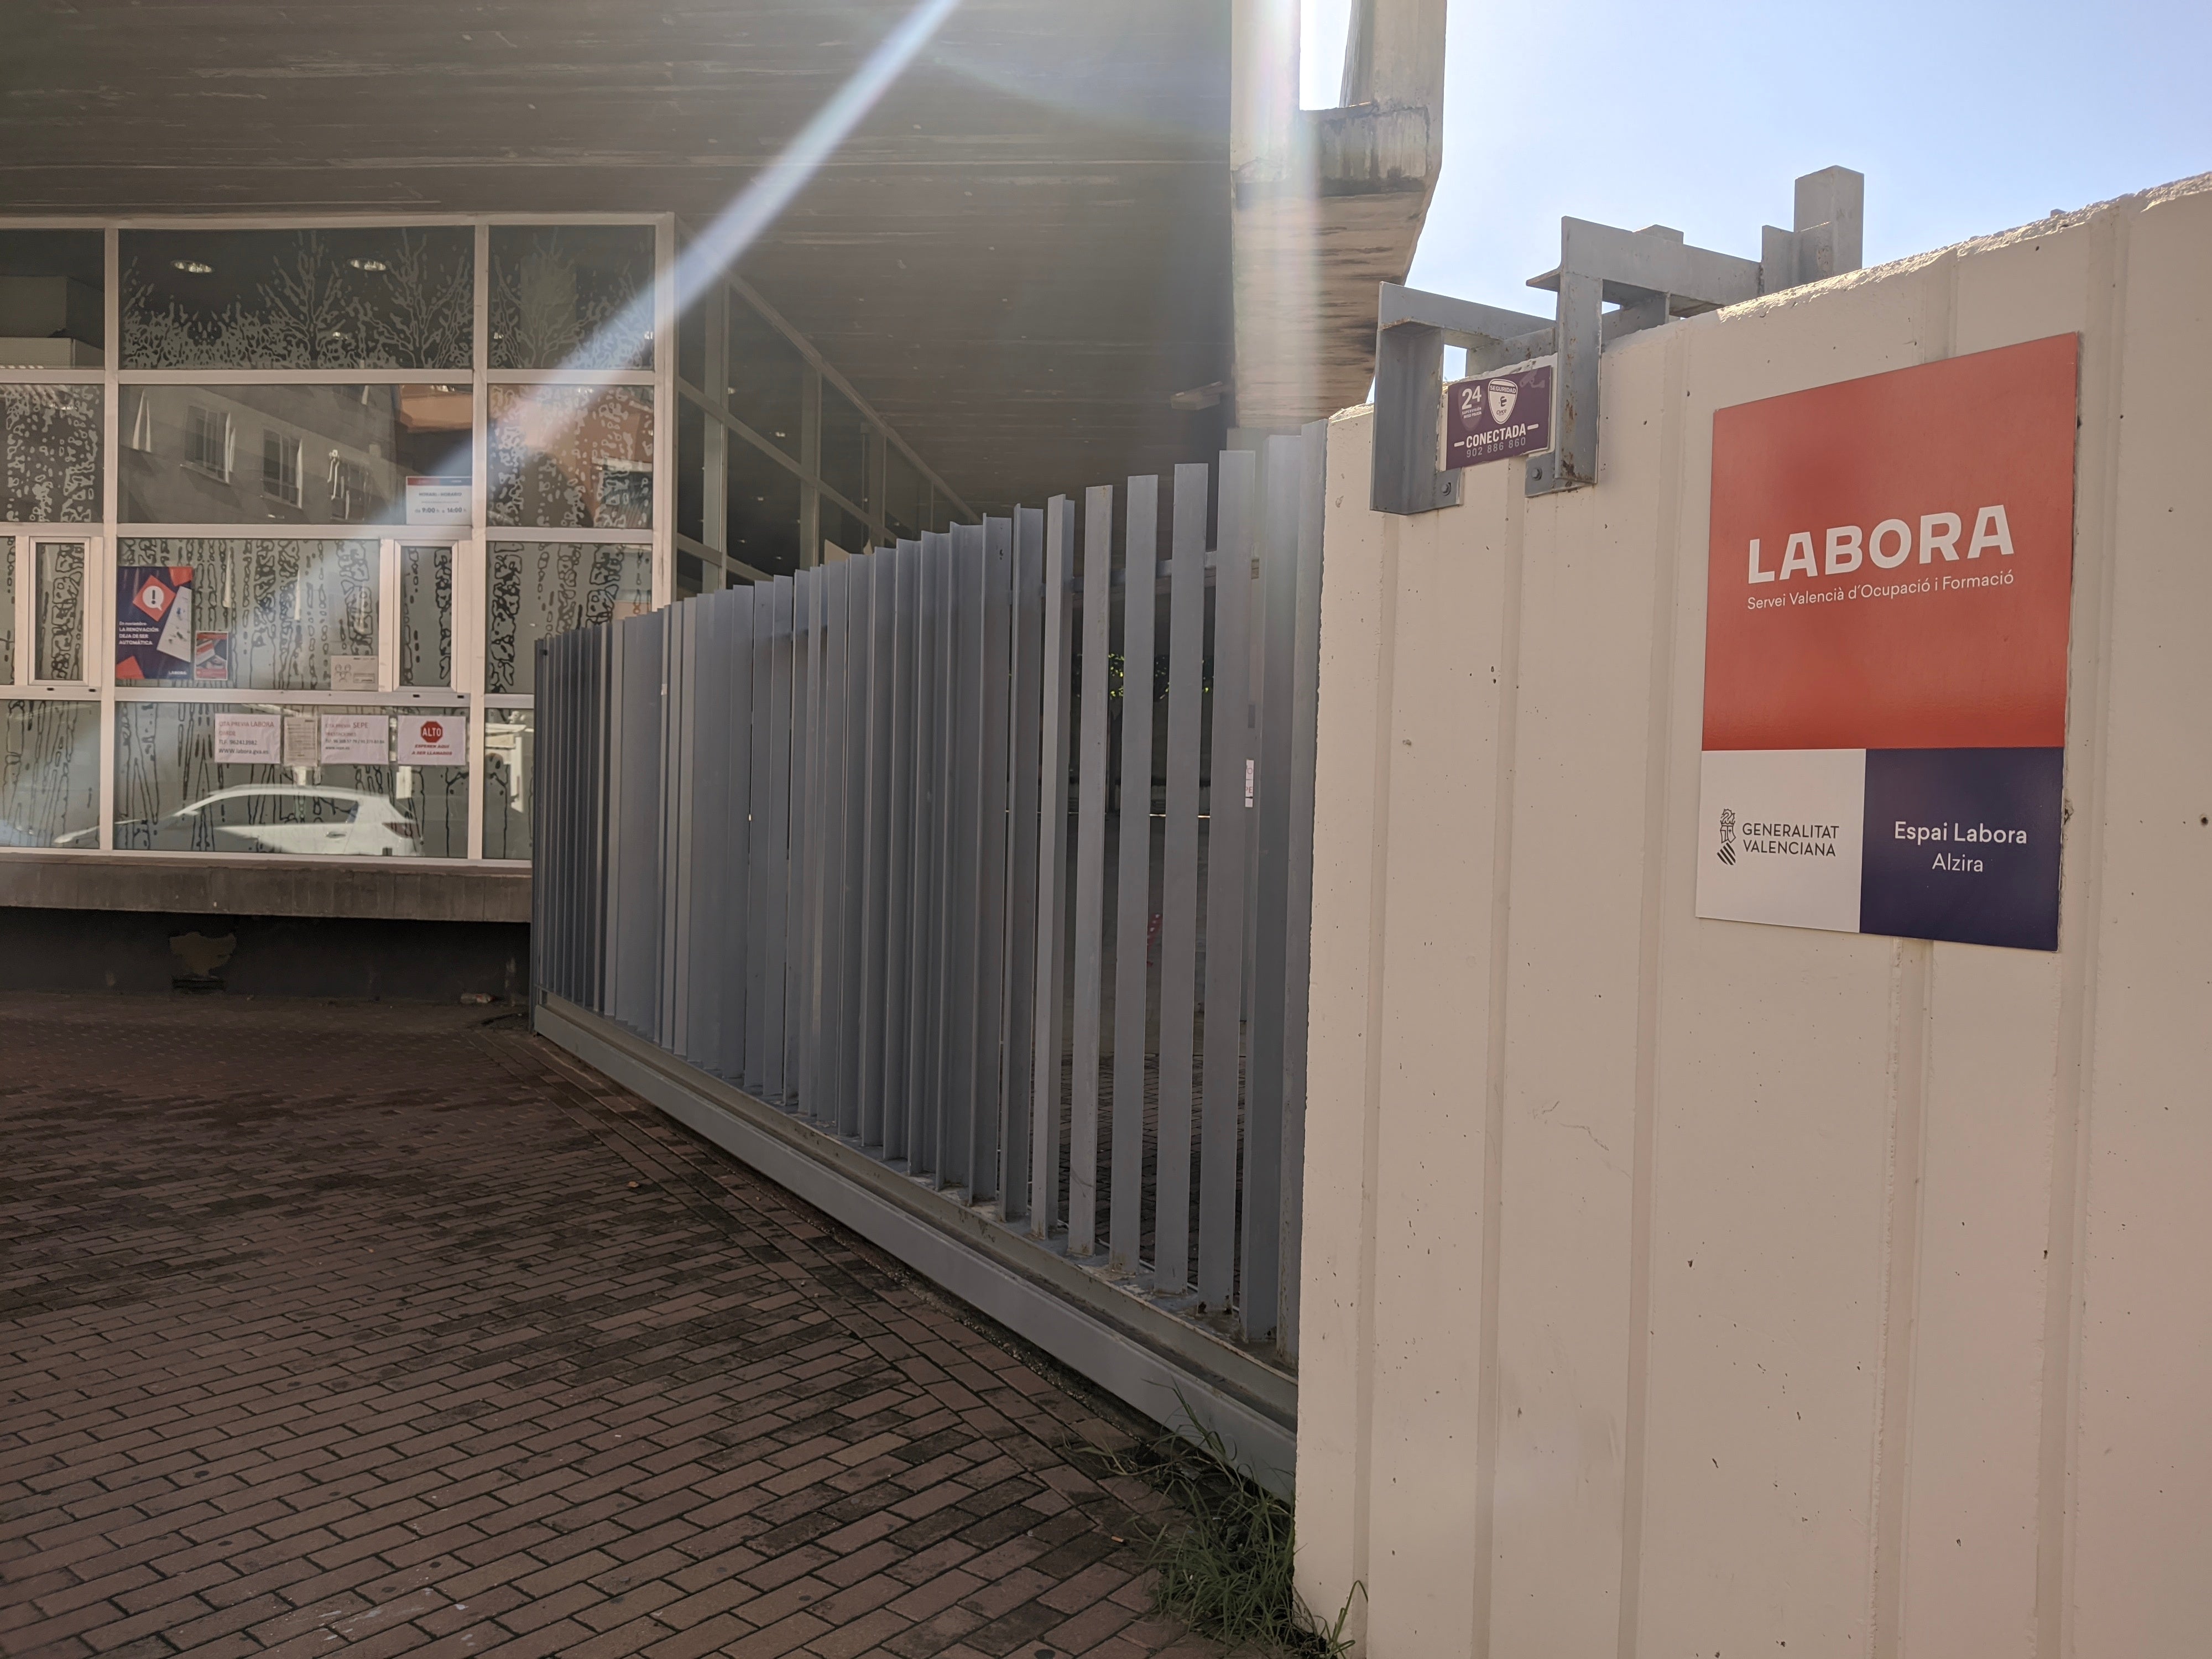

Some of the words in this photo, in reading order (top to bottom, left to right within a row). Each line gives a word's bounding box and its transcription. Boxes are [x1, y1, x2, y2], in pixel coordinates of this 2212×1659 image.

[1462, 385, 1482, 410] 24
[1490, 385, 1516, 394] SEGURIDAD
[1466, 423, 1526, 448] CONECTADA
[1467, 447, 1483, 458] 902
[1487, 442, 1504, 453] 886
[1509, 437, 1526, 448] 860
[1748, 504, 2014, 584] LABORA
[1747, 593, 1786, 609] Servei
[1789, 586, 1844, 605] Valencià
[1935, 577, 1938, 591] i
[1943, 570, 2014, 590] Formació
[422, 727, 441, 737] ALTO
[1743, 822, 1839, 839] GENERALITAT
[1895, 821, 1948, 846] Espai
[1954, 823, 2027, 844] Labora
[1743, 839, 1836, 857] VALENCIANA
[1932, 853, 1983, 872] Alzira
